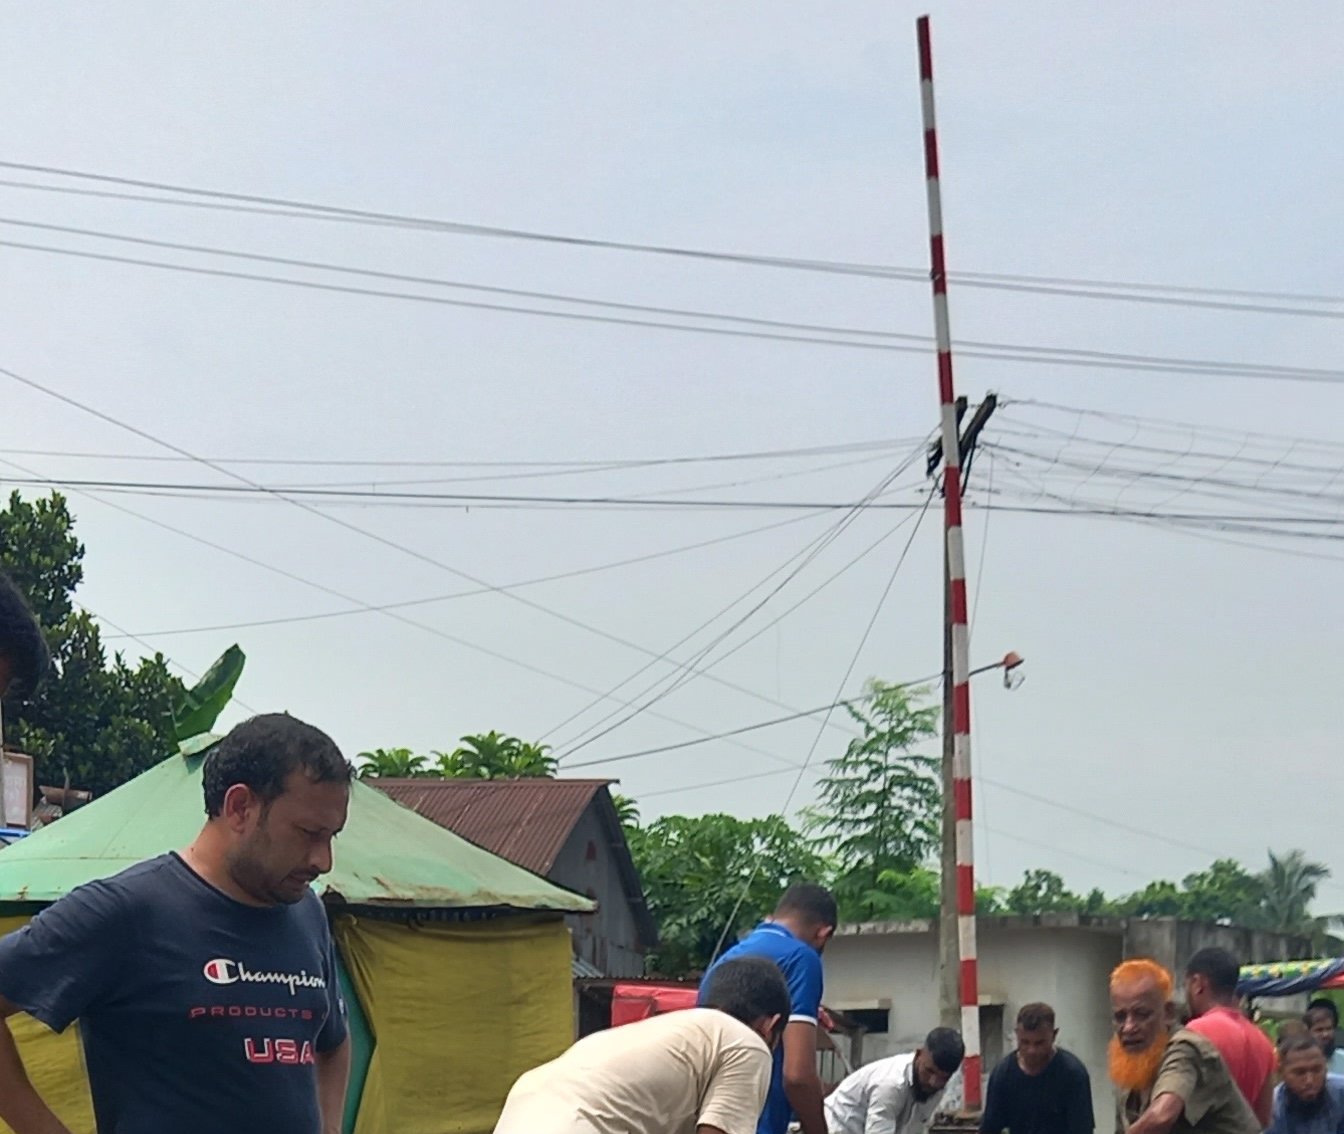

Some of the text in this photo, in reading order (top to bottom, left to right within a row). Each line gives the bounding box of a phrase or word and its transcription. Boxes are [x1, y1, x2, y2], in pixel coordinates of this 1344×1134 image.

[204, 958, 326, 995] Champion
[190, 1006, 313, 1019] PRODUCTS
[244, 1038, 316, 1065] USA
